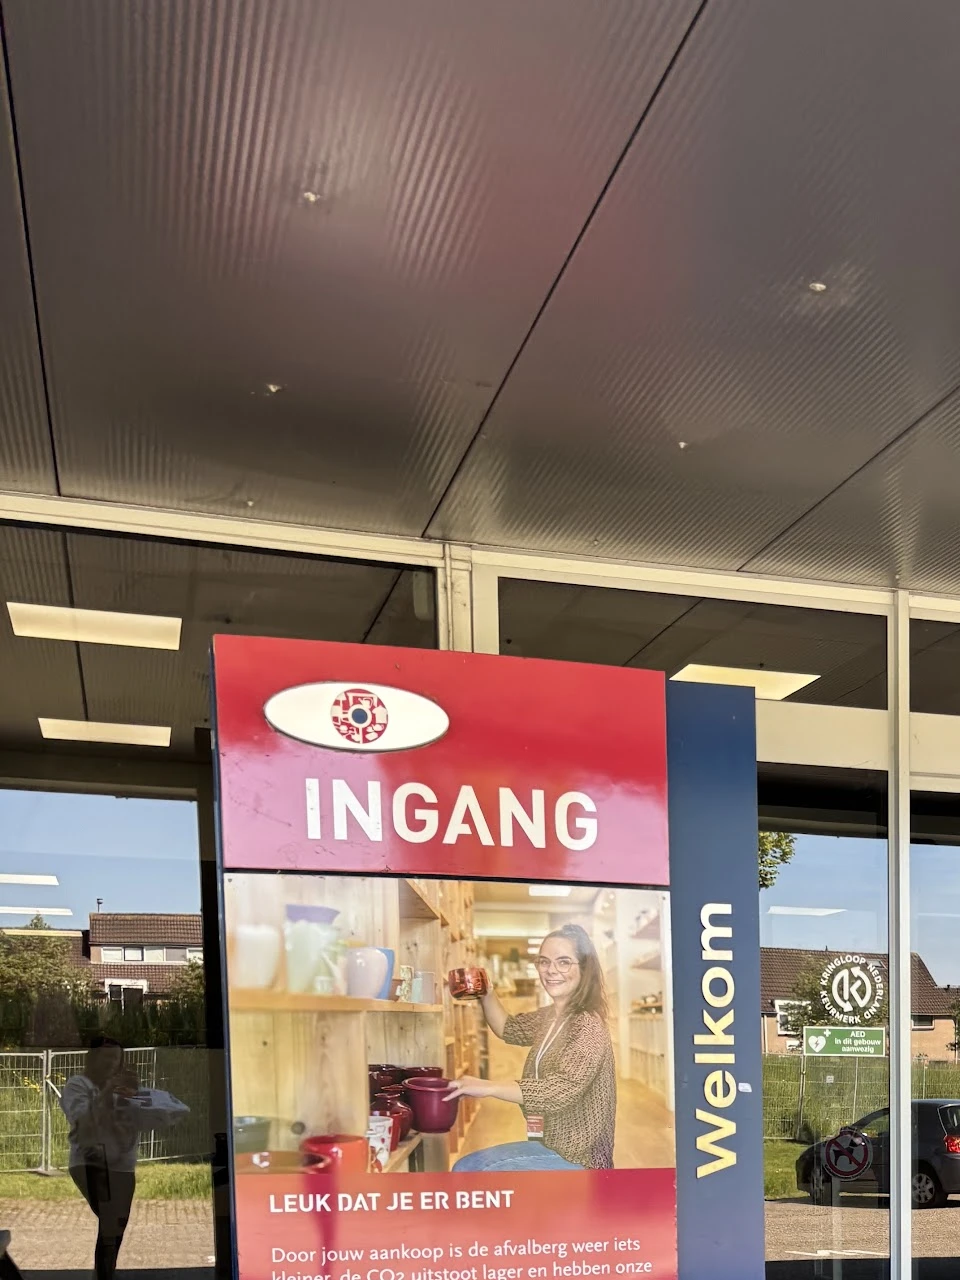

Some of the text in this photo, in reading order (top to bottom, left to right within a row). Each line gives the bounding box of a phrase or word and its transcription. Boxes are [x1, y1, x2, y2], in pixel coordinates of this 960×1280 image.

[305, 777, 599, 852] INGANG
[820, 954, 884, 1020] KRINGLOOP NEDERLAND
[819, 990, 862, 1024] KEURMERK
[694, 901, 738, 1178] Welkom
[843, 1037, 852, 1045] dit
[853, 1037, 882, 1048] gebouw
[850, 1030, 866, 1038] AED
[269, 1190, 515, 1213] LEUK DAT JE ER BENT
[271, 1237, 641, 1266] Door jouw aankoop is de afvalberg weer iets
[527, 1264, 547, 1278] en
[552, 1260, 611, 1277] hebben
[615, 1261, 652, 1274] onze
